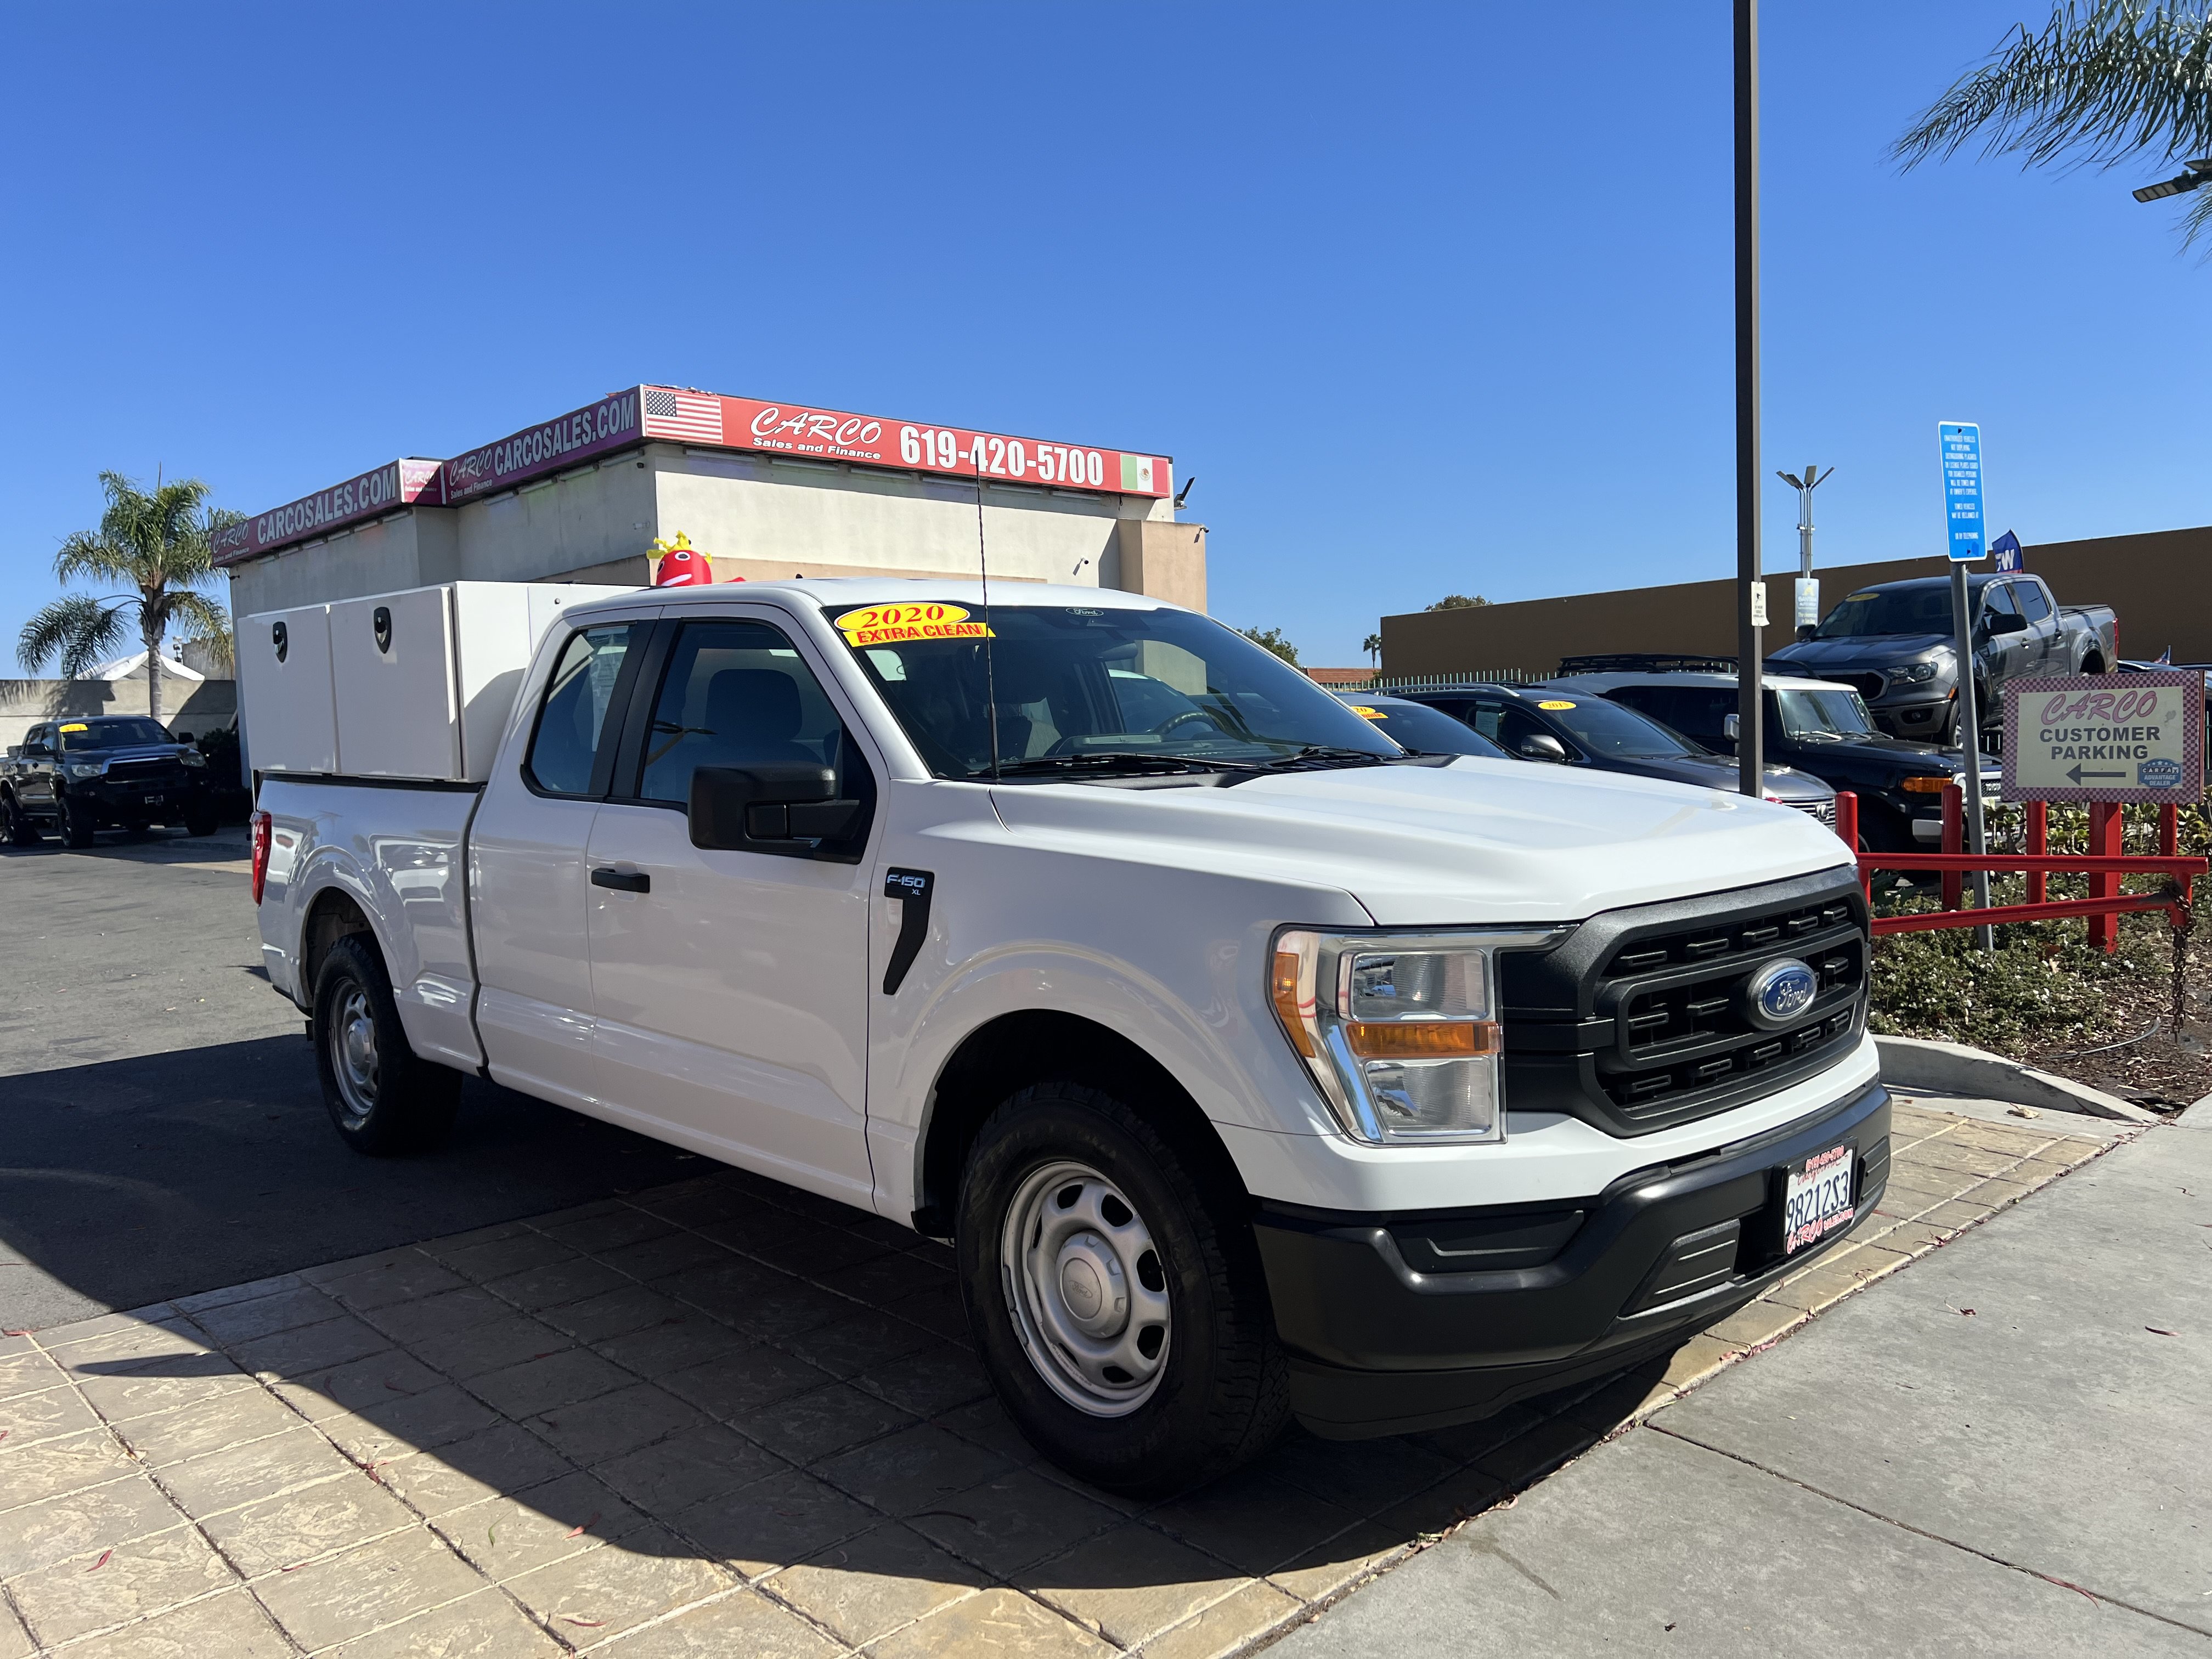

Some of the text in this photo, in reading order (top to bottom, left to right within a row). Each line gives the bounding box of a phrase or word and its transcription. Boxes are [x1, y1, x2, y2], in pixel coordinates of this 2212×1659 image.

[495, 393, 635, 477] CARCOSALES.COM
[750, 407, 882, 446] CARCO
[752, 437, 882, 460] Sales and Finance
[899, 425, 1104, 486] 619-420-5700
[449, 448, 493, 487] CARCO
[450, 478, 493, 500] Sales and Finance
[257, 466, 396, 545] CARCOSALES.COM
[213, 522, 249, 554] CARCO
[861, 606, 944, 628] 2020
[856, 624, 985, 644] EXTRA CLEAN
[2041, 691, 2158, 725] CARCO
[2040, 726, 2160, 742] CUSTOMER
[2051, 745, 2148, 760] PARKING
[887, 874, 926, 888] F-150
[1776, 978, 1808, 1011] Ford
[1785, 1170, 1848, 1237] 98212S3
